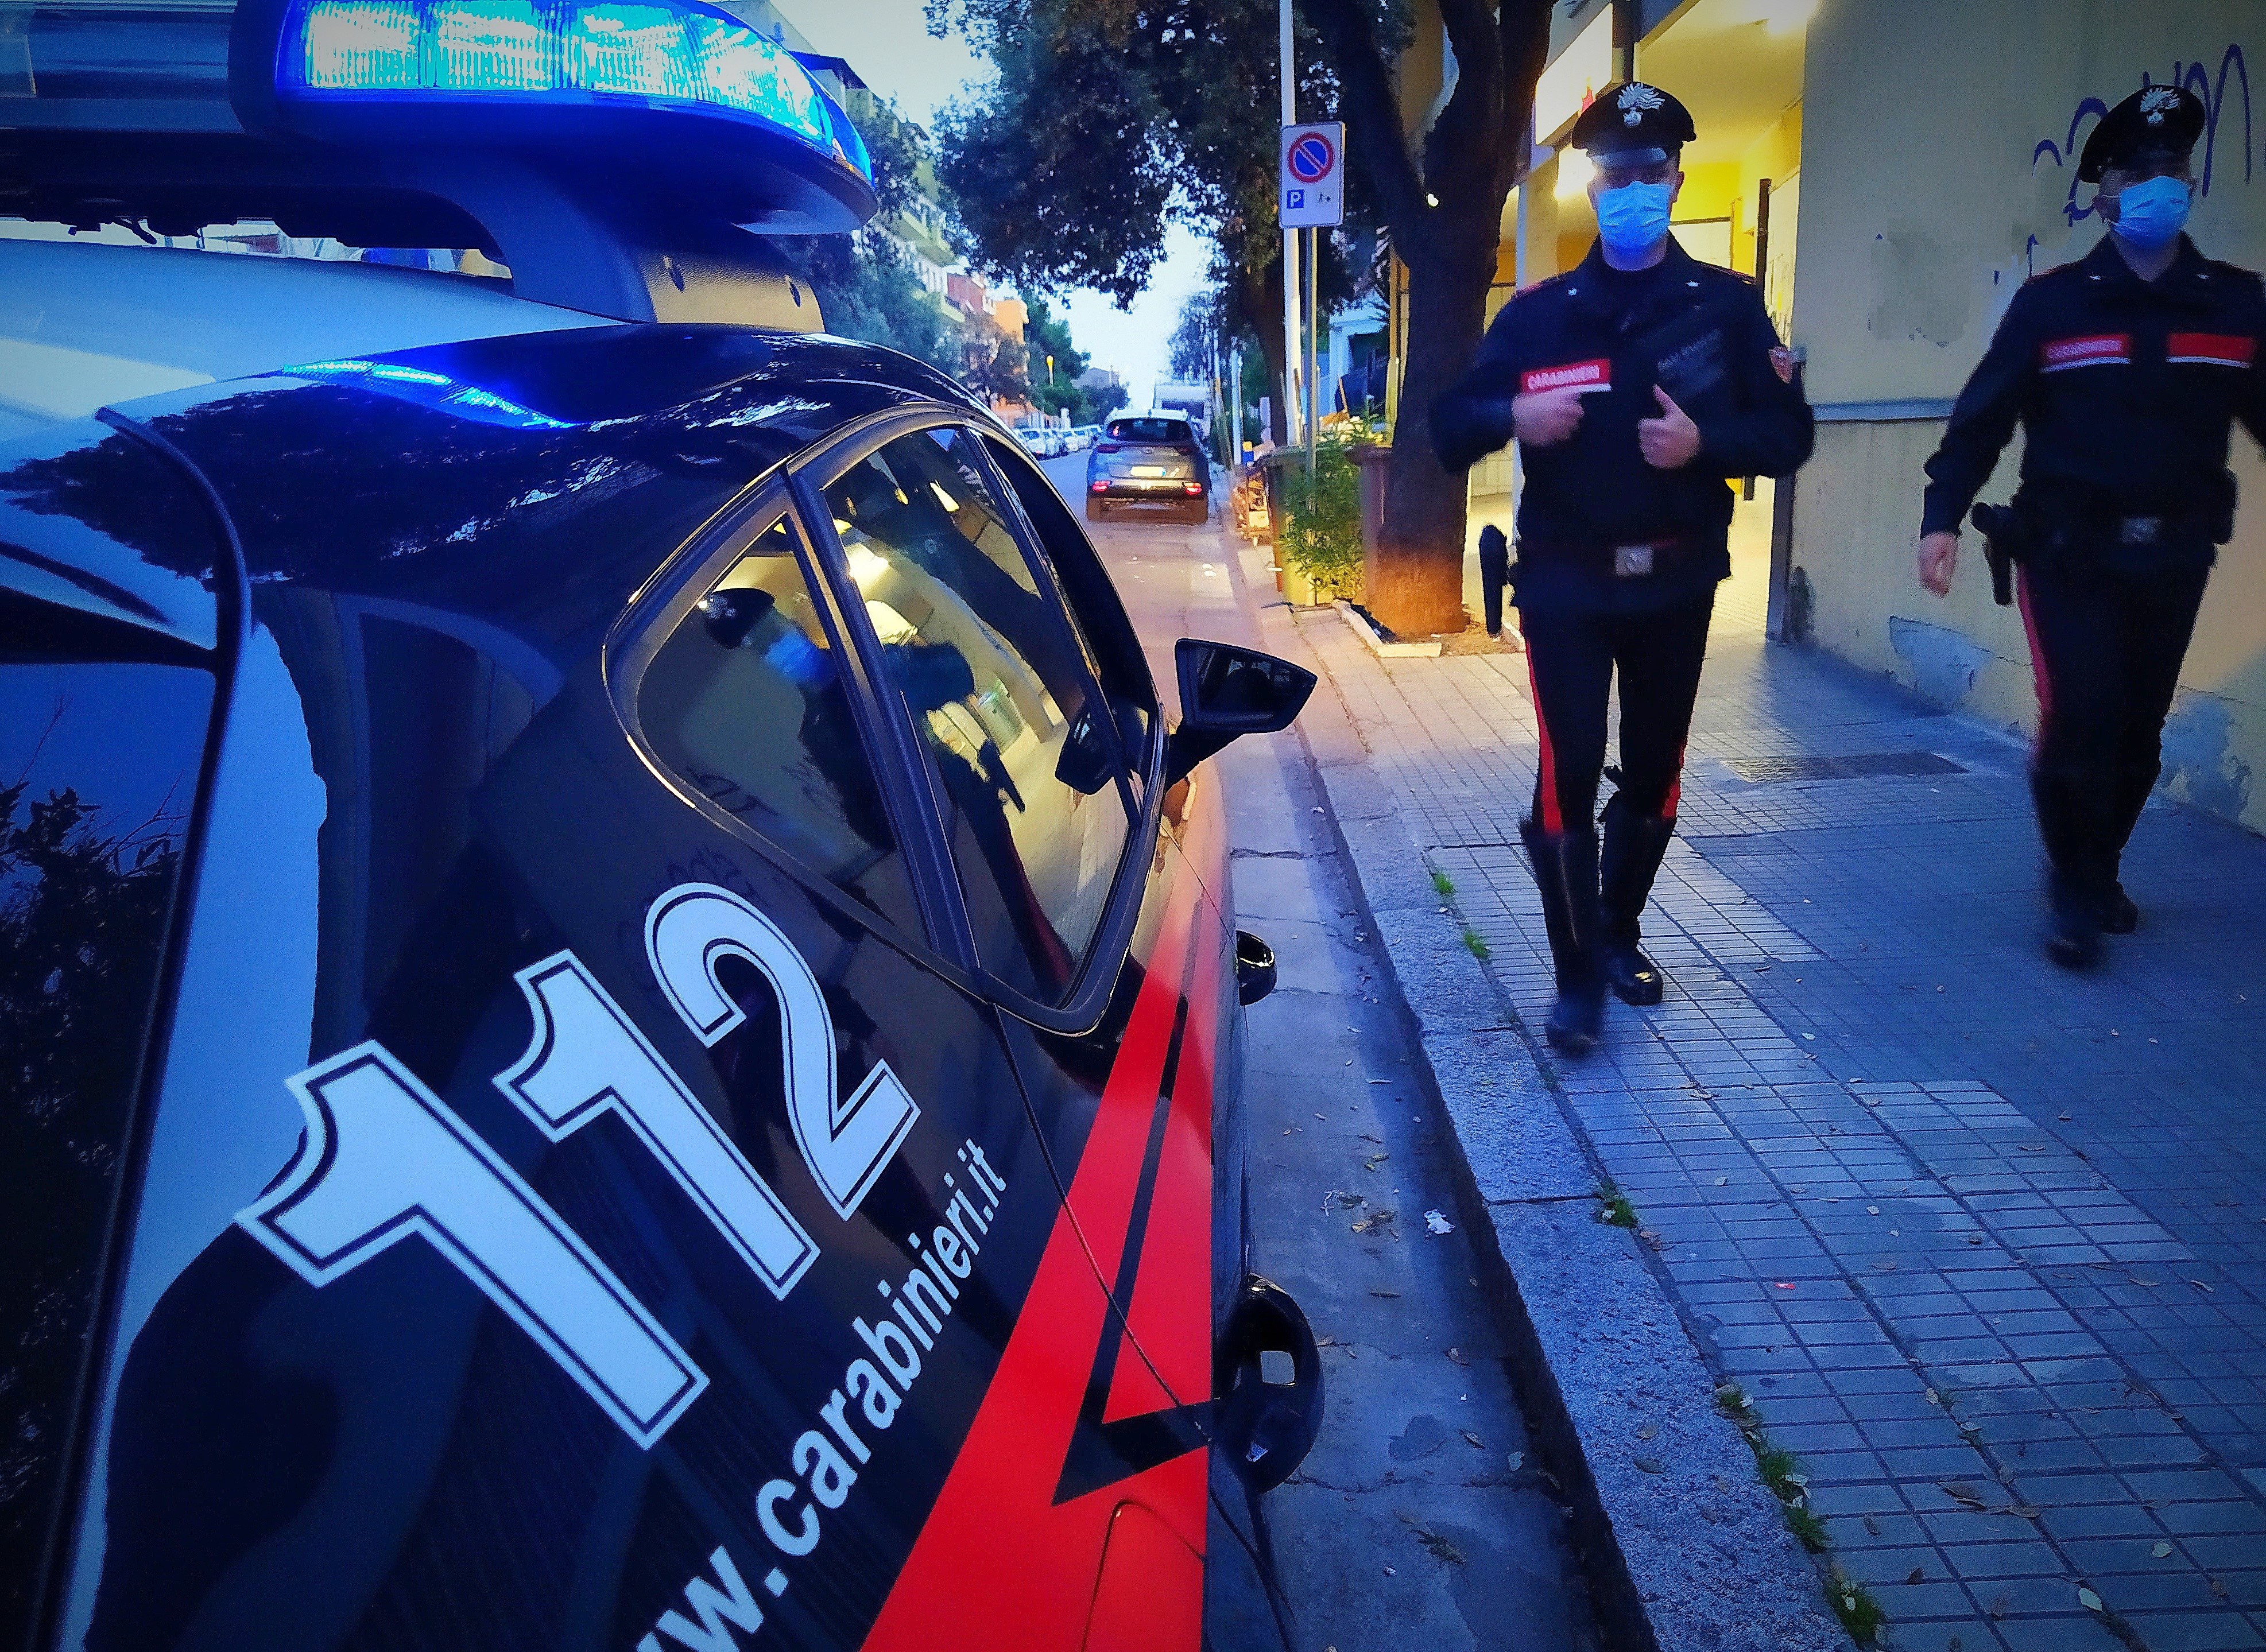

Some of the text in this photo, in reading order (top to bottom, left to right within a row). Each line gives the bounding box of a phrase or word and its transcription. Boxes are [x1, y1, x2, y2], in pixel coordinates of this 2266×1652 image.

[1290, 191, 1302, 208] P
[234, 882, 921, 1451] 112
[636, 1138, 1007, 1652] w.carabinieri.it
